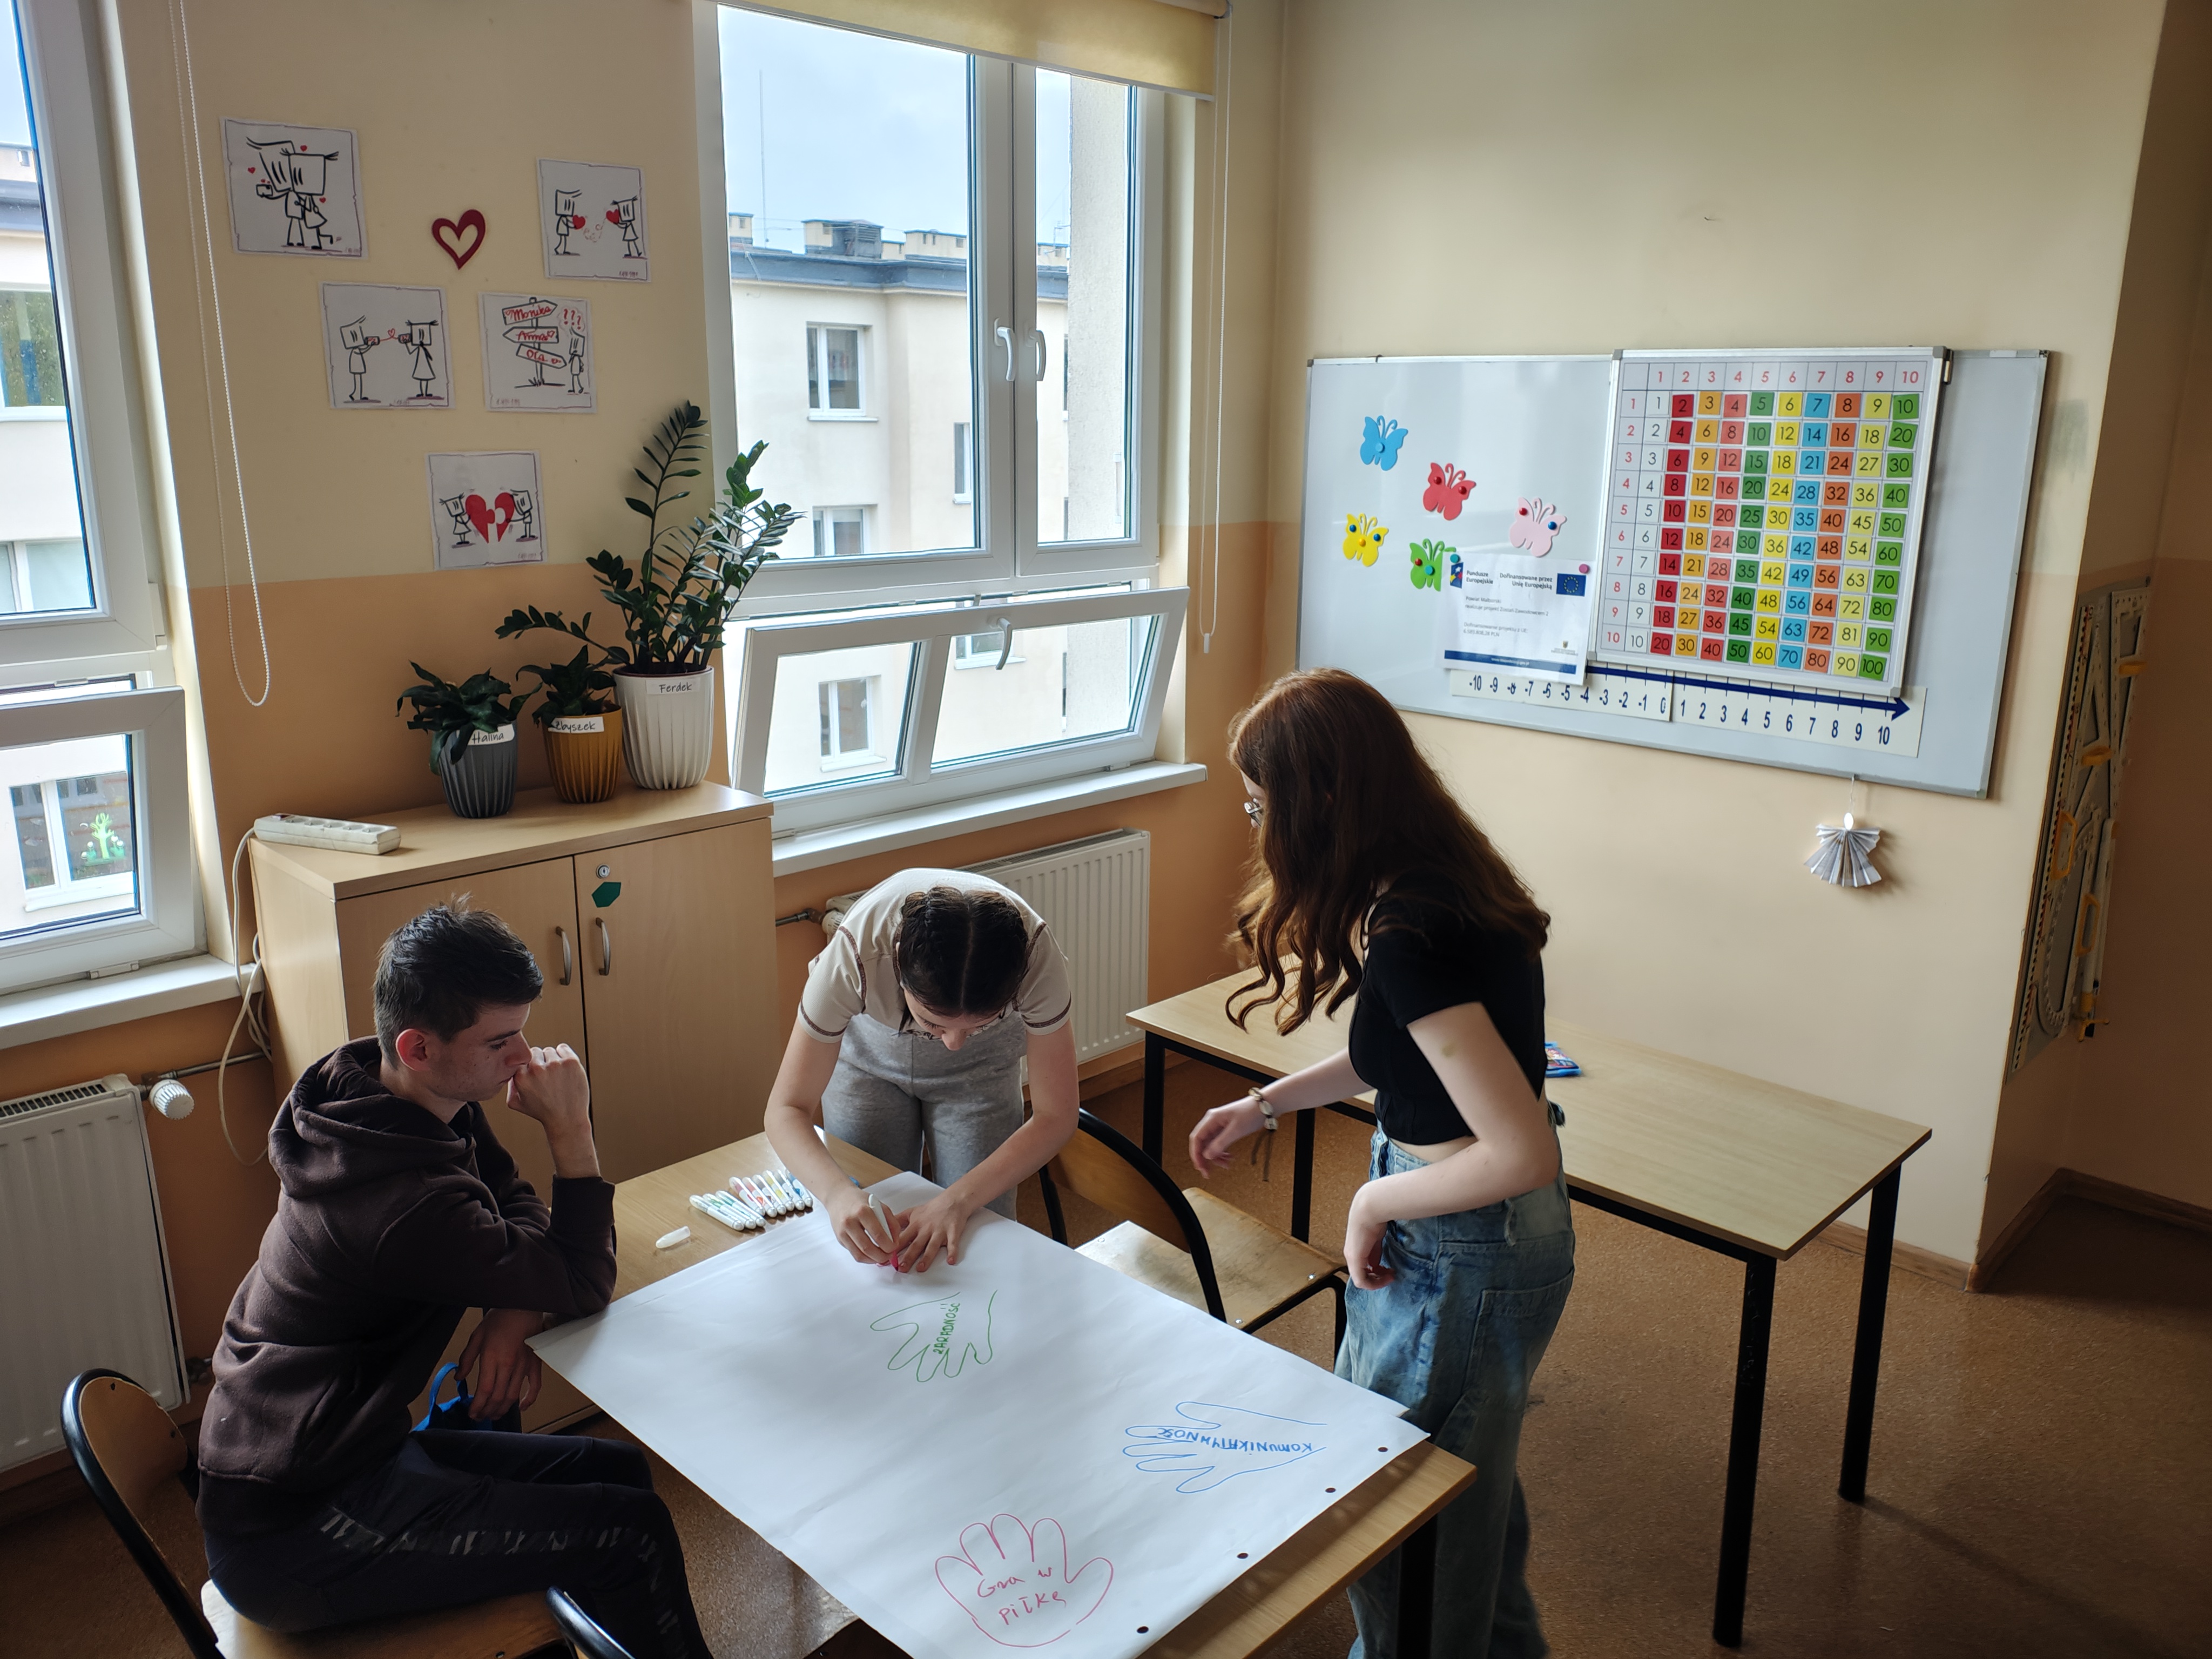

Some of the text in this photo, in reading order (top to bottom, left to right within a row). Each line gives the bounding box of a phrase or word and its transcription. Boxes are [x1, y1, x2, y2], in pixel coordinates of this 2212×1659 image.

[1658, 371, 1918, 383] 1 2 3 4 5 6 7 8 9 10
[1657, 396, 1913, 414] 1 2 3 4 5 6 7 8 9 10
[1651, 424, 1912, 444] 2 4 6 8 10 12 14 16 18 20
[1648, 452, 1909, 472] 3 6 9 12 15 18 21 24 27 30
[1646, 478, 1905, 502] 4 8 12 16 20 24 28 32 36 40
[1645, 504, 1901, 532] 5 10 15 20 25 30 35 40 45 50
[1642, 530, 1898, 561] 6 12 18 36 42 48 54 60
[1500, 572, 1537, 581] Dofinansowane
[1525, 582, 1553, 590] Europejską
[1637, 583, 1892, 616] 8 16 24 32 40 48 56 64 72 80
[1636, 607, 1887, 647] 9 18 27 36 45 54 63 72 81 90
[1631, 635, 1883, 675] 10 20 30 40 50 60 70 80 90 100
[659, 682, 692, 694] Ferdek
[1469, 675, 1481, 691] -10
[1489, 677, 1498, 692] -9
[1525, 680, 1534, 696] -7
[1561, 685, 1570, 701] -5
[1580, 686, 1589, 703] -4
[1600, 689, 1608, 705] -3
[1619, 691, 1628, 708] -2
[1638, 694, 1647, 711] -1
[1660, 697, 1666, 713] 0
[1681, 699, 1685, 717] 1
[1699, 702, 1707, 719] 2
[1721, 705, 1727, 723] 3
[1742, 708, 1748, 726] 4
[1764, 711, 1771, 729] 5
[1786, 714, 1793, 732] 6
[1809, 717, 1816, 735] 7
[1831, 720, 1839, 738] 8
[1855, 723, 1862, 741] 9
[1878, 726, 1890, 745] 10
[555, 720, 596, 733] Zbyszek
[471, 731, 504, 744] Halina
[977, 1576, 1026, 1598] Gra
